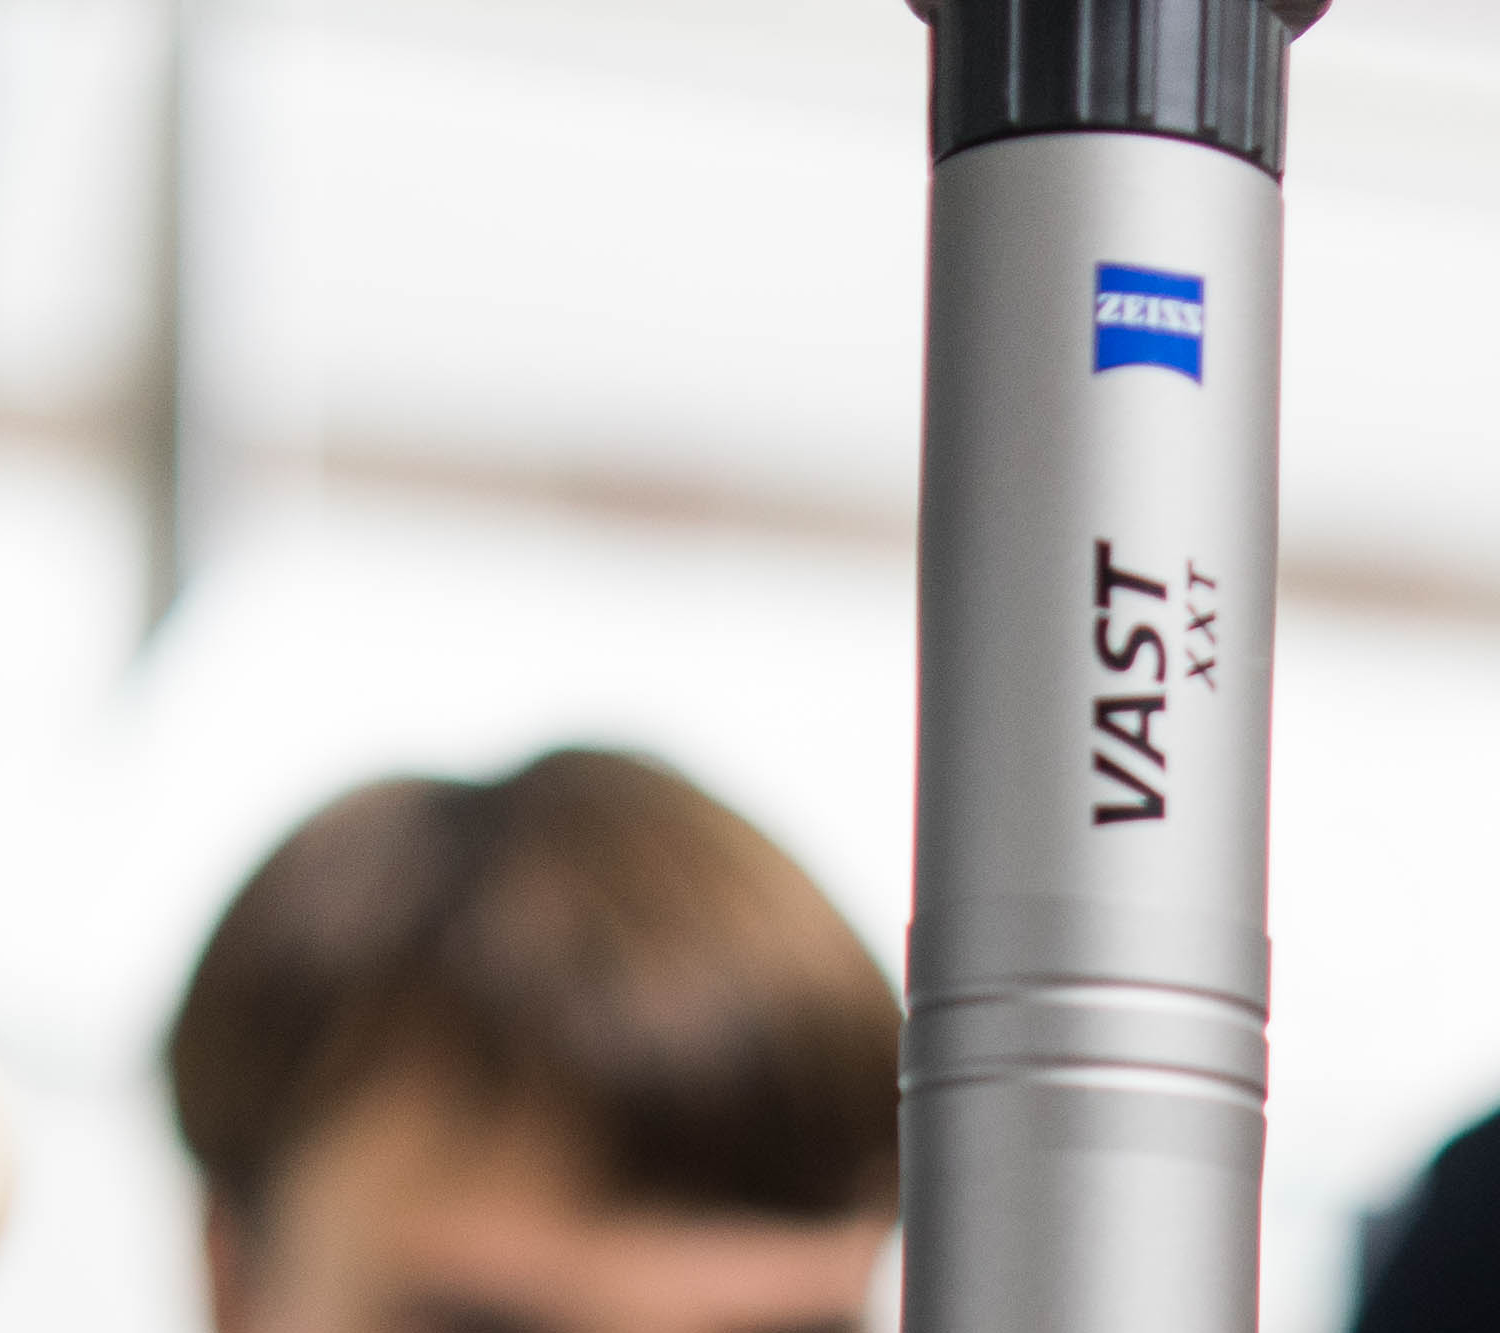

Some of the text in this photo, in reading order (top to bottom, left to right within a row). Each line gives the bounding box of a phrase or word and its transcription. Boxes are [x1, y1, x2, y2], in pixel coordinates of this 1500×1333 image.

[1097, 291, 1202, 335] ZEISS
[1091, 537, 1168, 826] VAST
[1186, 558, 1218, 692] XXT
